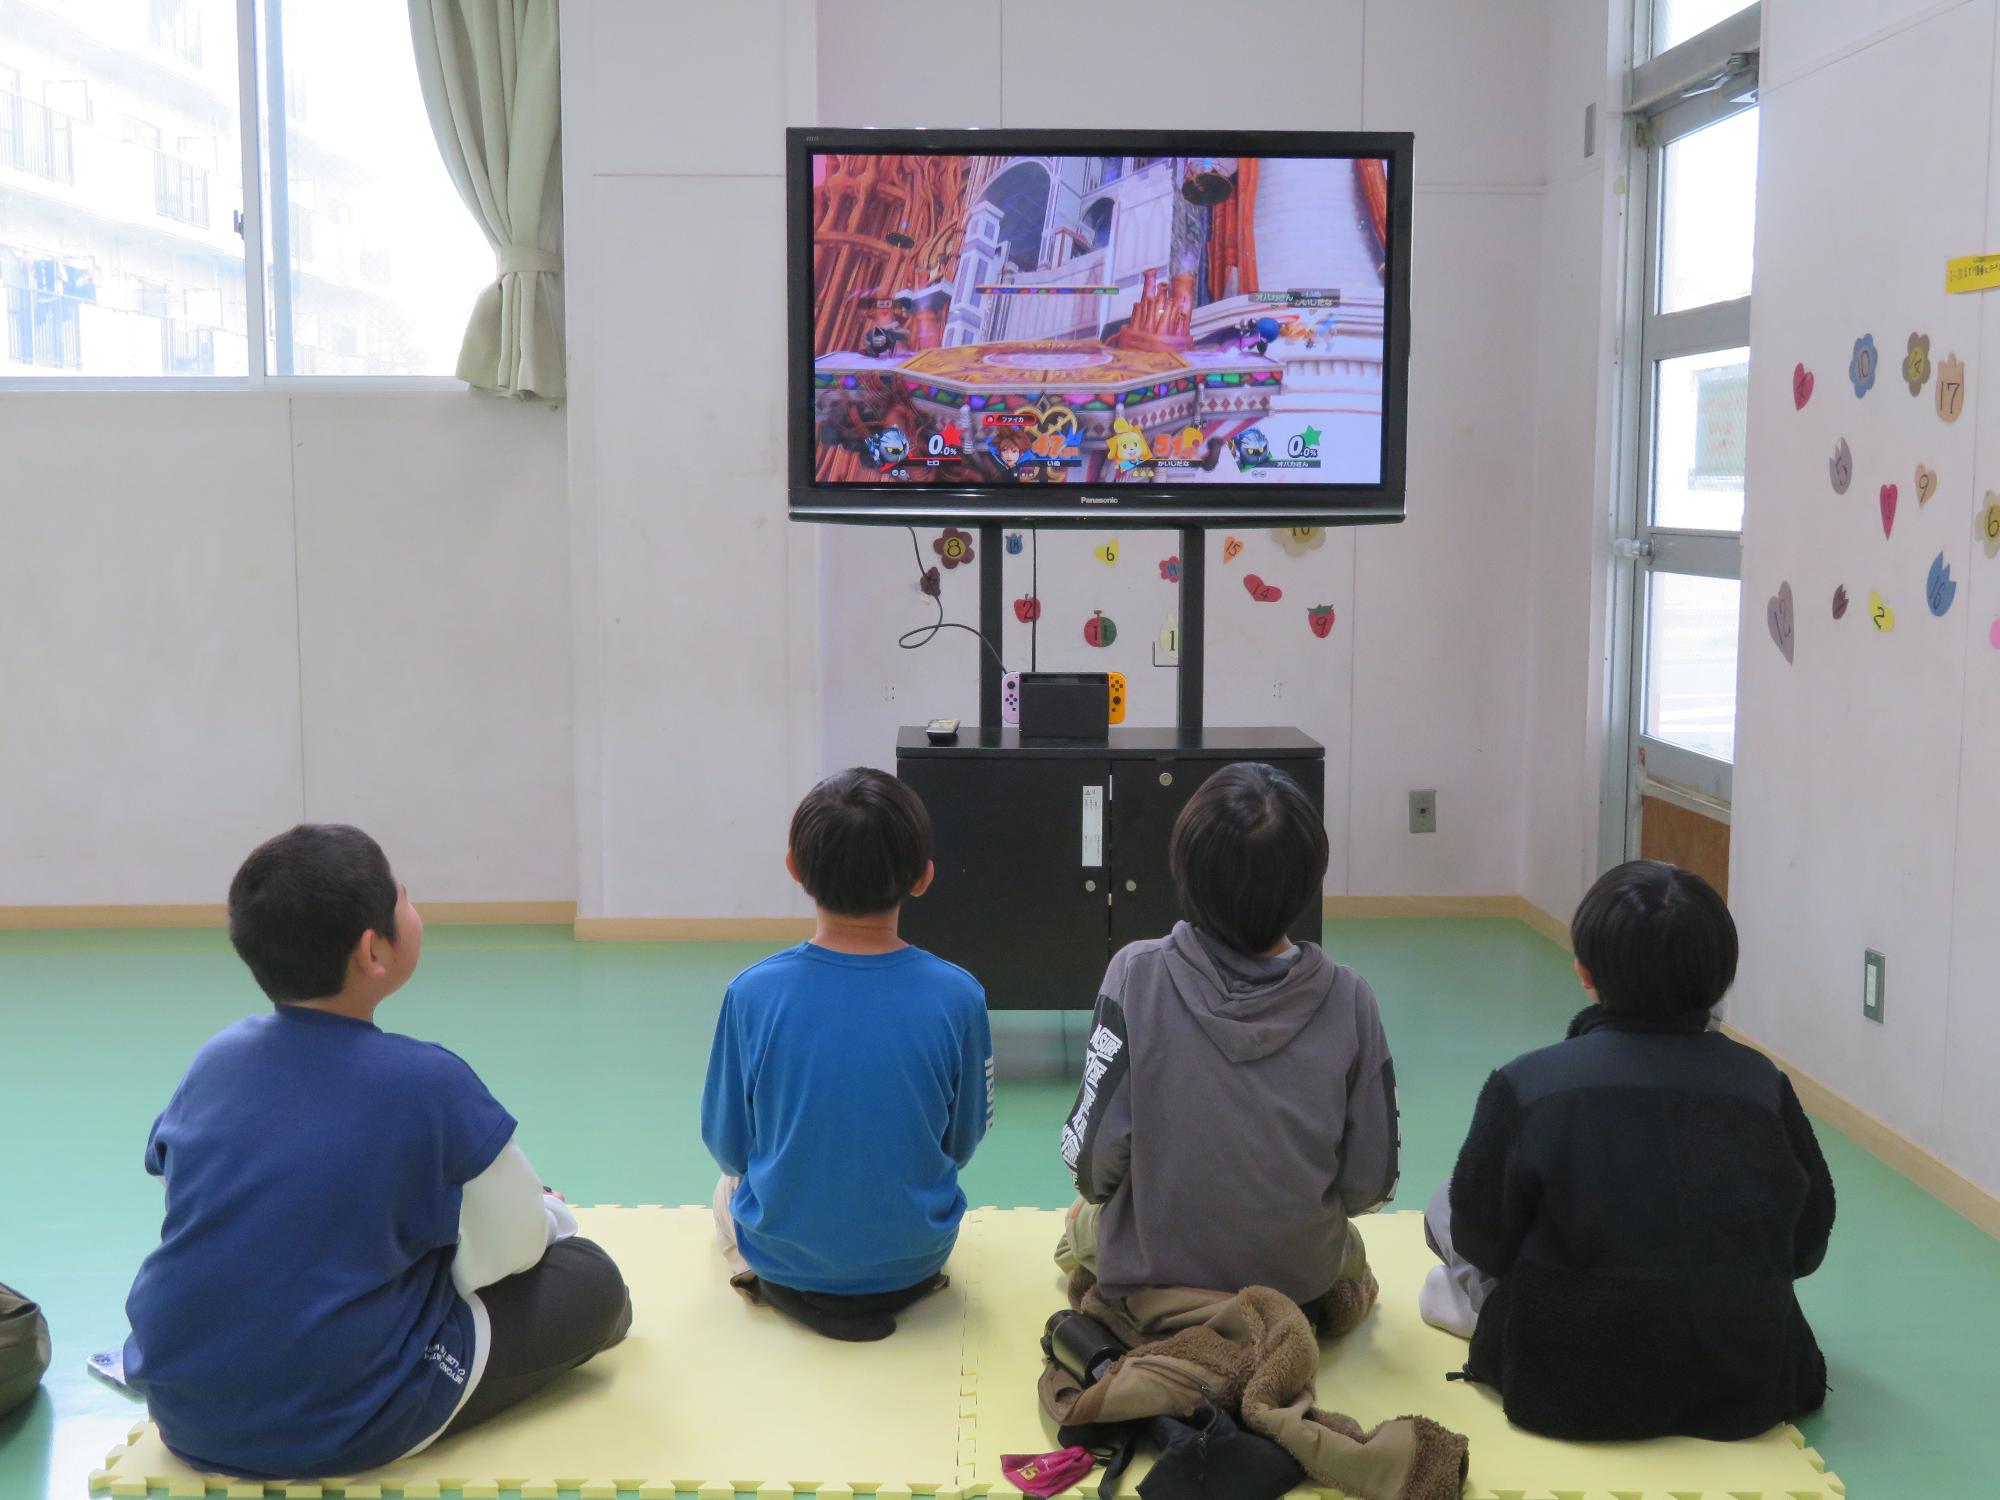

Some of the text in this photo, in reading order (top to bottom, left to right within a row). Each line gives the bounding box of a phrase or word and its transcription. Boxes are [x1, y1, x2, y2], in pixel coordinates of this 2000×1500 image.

[1939, 380, 1961, 415] 17
[1918, 473, 1930, 504] 9
[1080, 496, 1119, 504] Panasonic
[1986, 507, 2000, 539] 6
[946, 538, 962, 558] 8
[1105, 546, 1116, 562] 6
[1225, 540, 1241, 557] 15
[1022, 600, 1034, 620] 2
[1873, 606, 1886, 630] 2
[1315, 616, 1328, 636] 9
